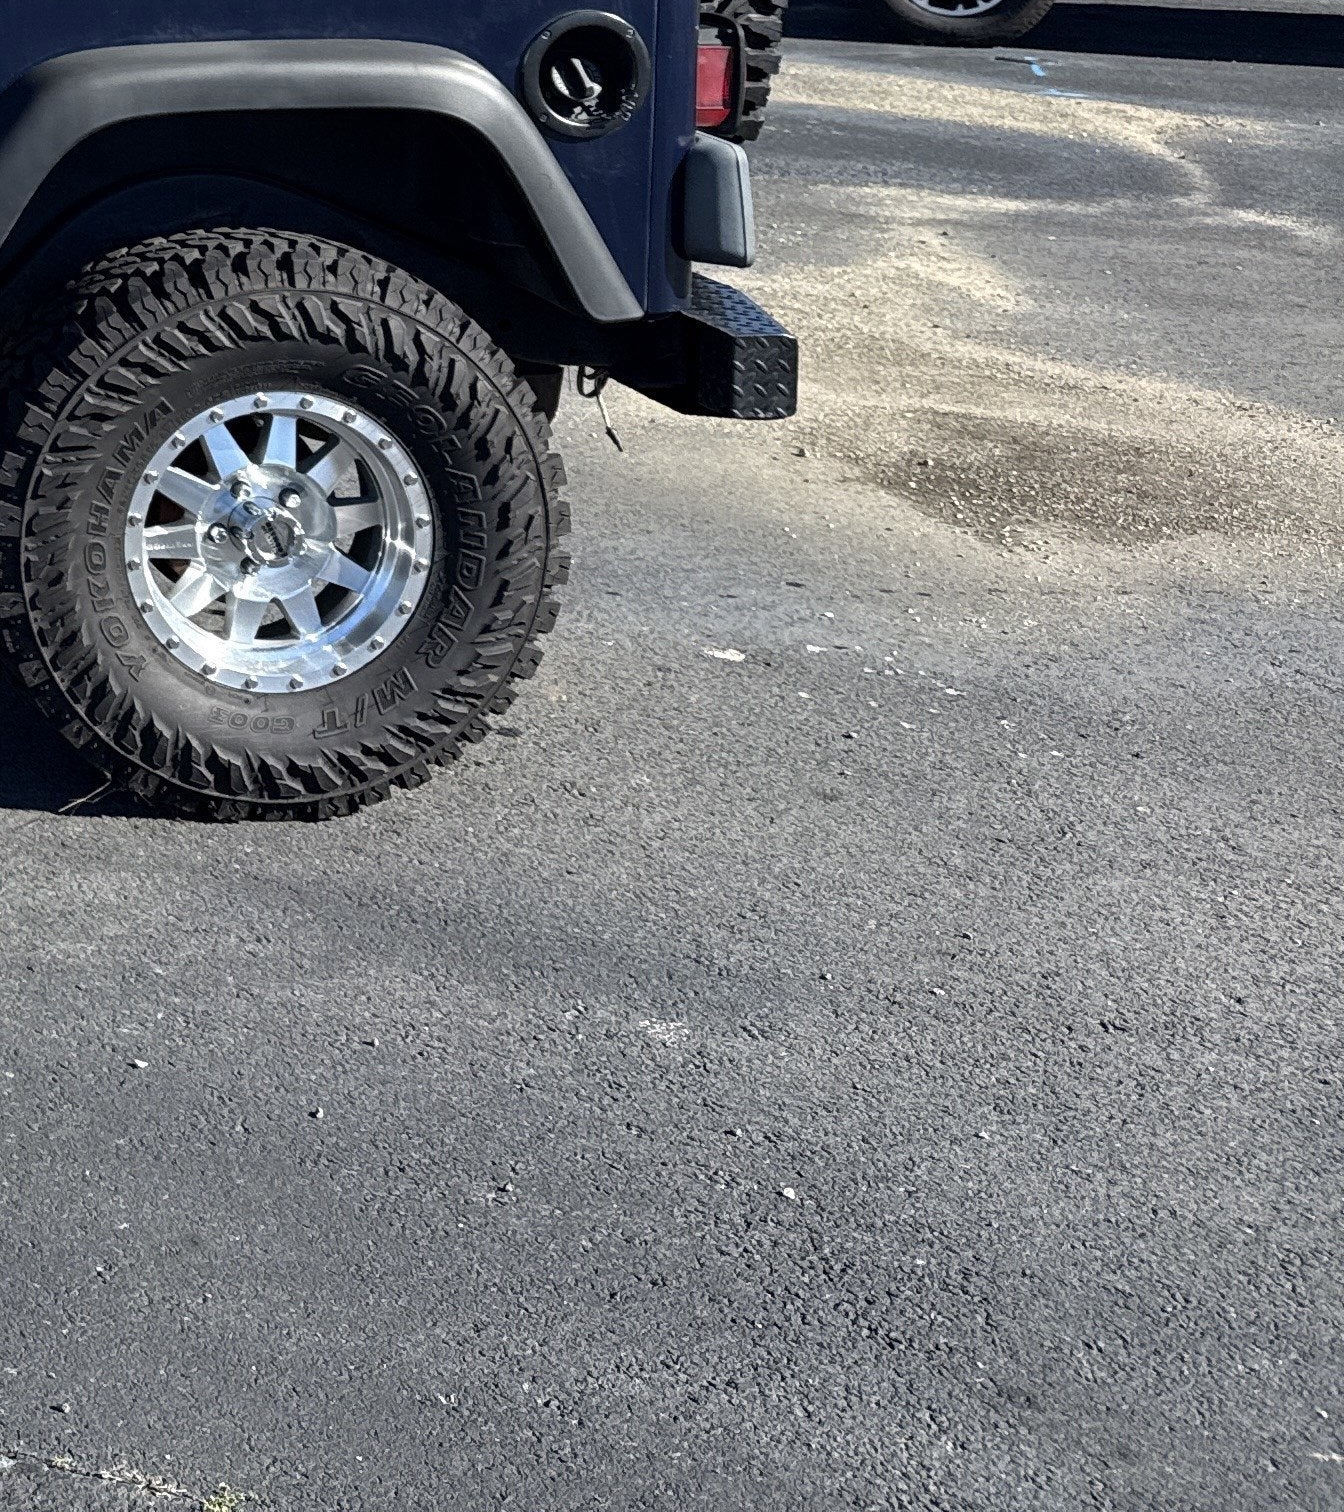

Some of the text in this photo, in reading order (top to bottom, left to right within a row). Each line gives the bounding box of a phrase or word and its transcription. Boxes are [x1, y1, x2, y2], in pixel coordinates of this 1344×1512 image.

[84, 396, 175, 682] YOKOHAMA
[343, 365, 488, 669] GEOLANDAR
[312, 665, 419, 739] M/T
